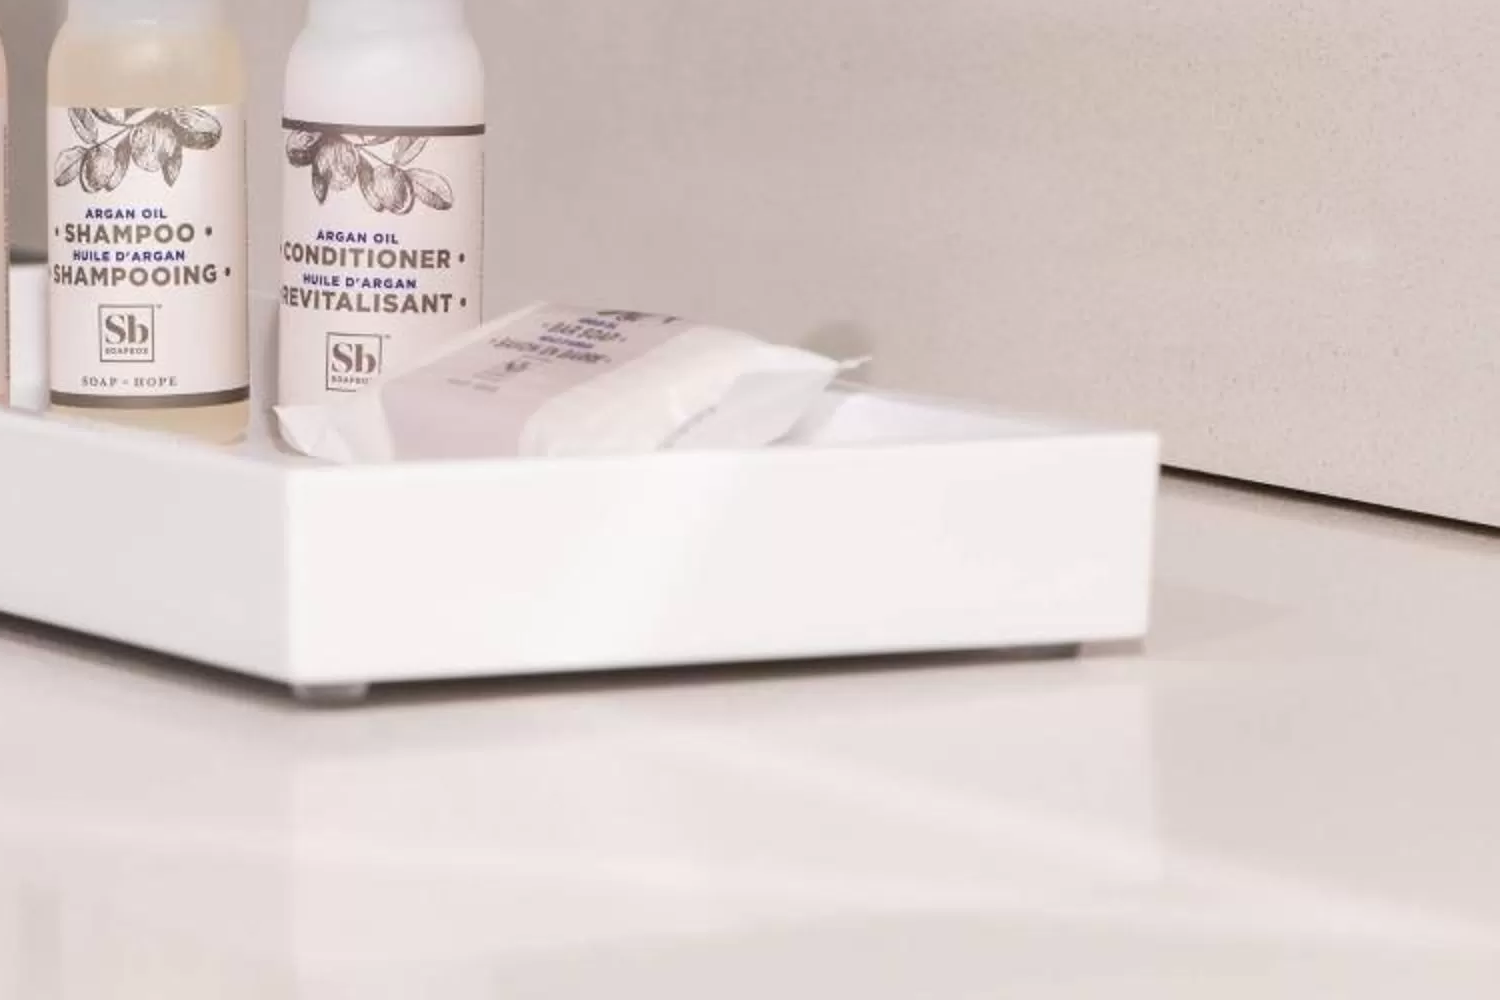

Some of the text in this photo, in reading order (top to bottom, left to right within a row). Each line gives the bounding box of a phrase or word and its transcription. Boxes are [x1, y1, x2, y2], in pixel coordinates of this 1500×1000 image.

[85, 208, 167, 220] ARGAN OIL
[64, 223, 195, 244] SHAMPOO
[316, 230, 400, 245] ARGAN OIL
[73, 249, 185, 261] HUILE D'ARGAN
[282, 242, 452, 269] CONDITIONER
[53, 263, 218, 287] SHAMPOOING
[302, 273, 417, 289] HUILE D'ARGAN
[282, 285, 453, 314] REVITALISANT
[105, 313, 148, 345] Sb
[331, 342, 377, 375] Sb
[81, 376, 118, 388] SOAP
[134, 376, 178, 388] HOPE
